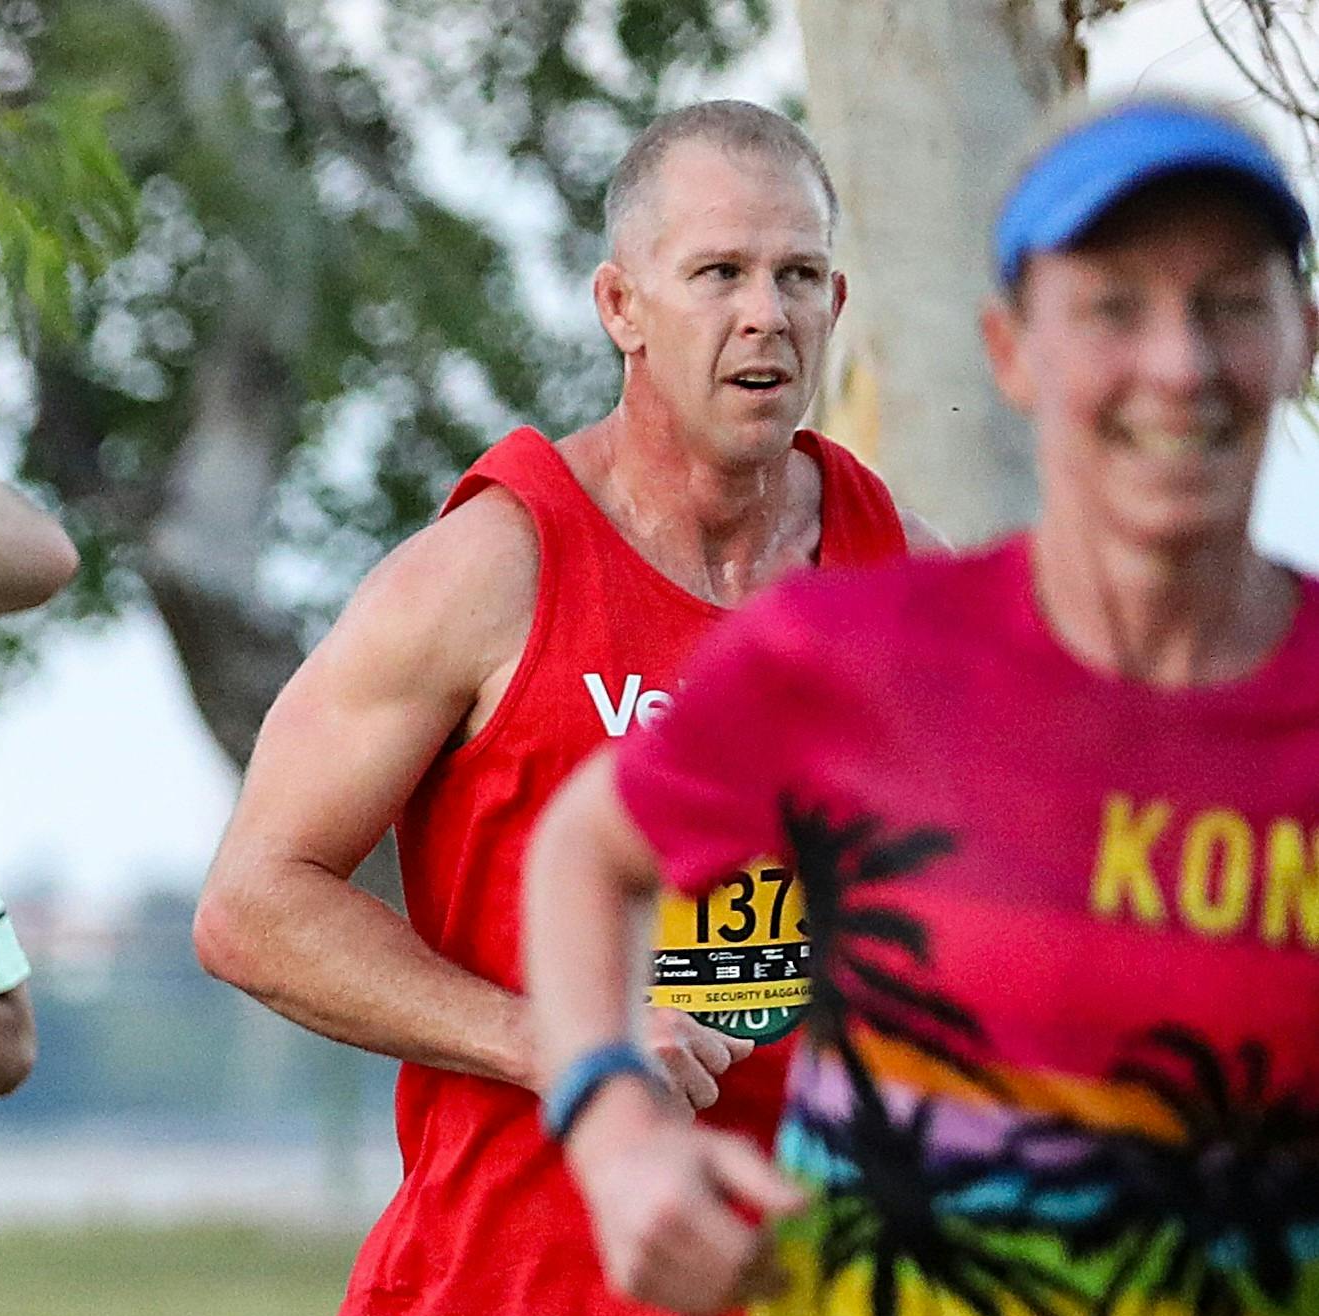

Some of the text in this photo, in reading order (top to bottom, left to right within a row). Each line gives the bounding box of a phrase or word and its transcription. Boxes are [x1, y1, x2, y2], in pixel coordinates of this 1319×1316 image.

[583, 673, 677, 737] Ve
[696, 867, 810, 944] 137
[705, 990, 762, 1003] SECURITY
